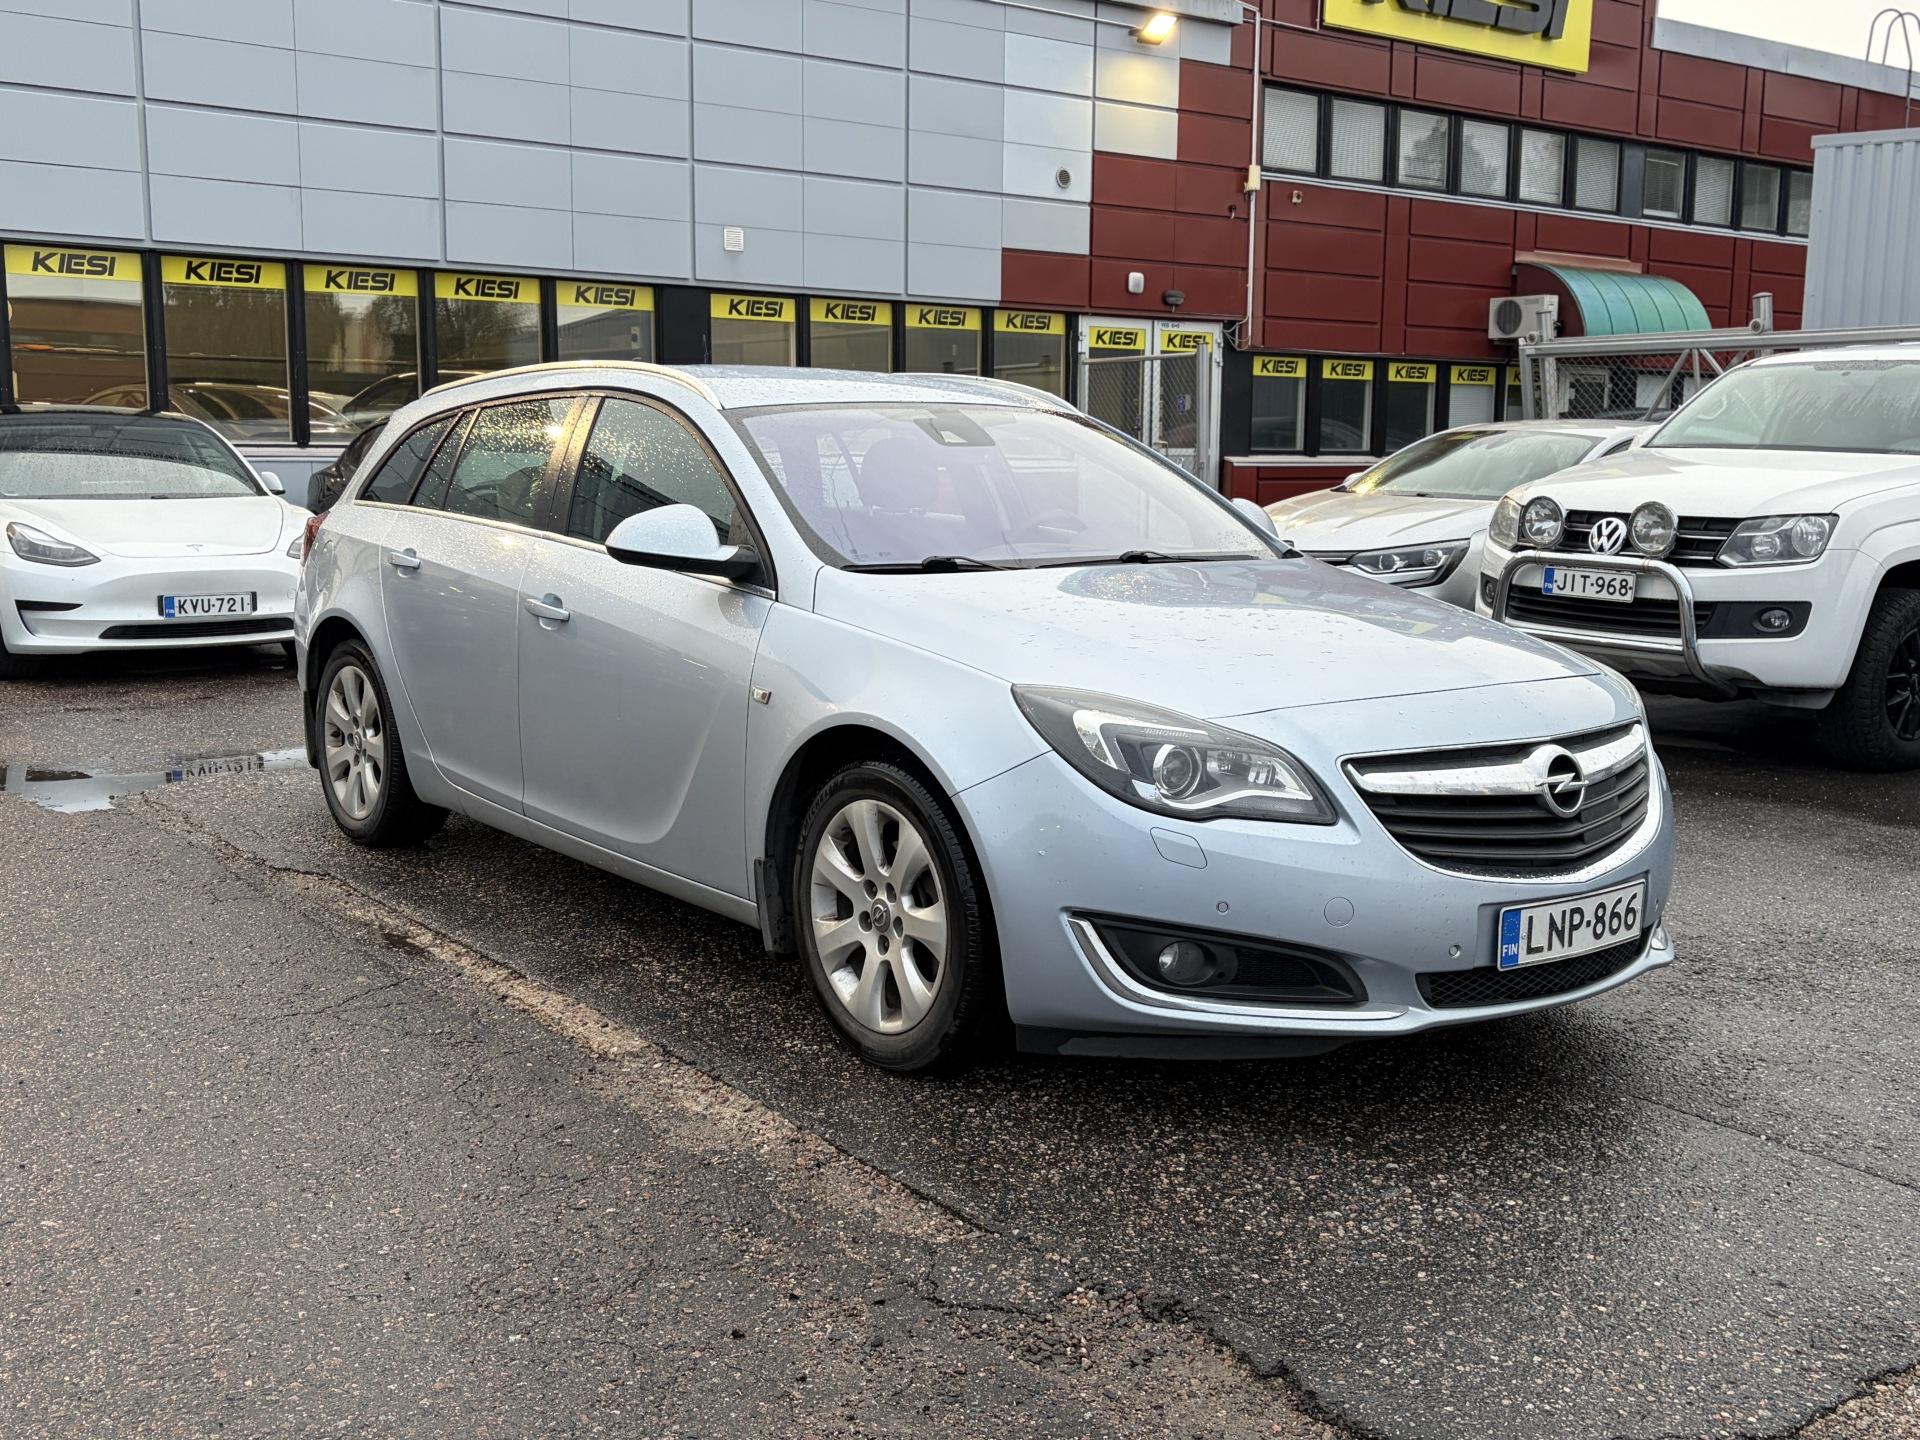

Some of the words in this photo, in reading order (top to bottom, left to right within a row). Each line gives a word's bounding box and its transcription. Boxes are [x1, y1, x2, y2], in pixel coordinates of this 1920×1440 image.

[32, 251, 116, 276] KIESI
[186, 260, 262, 283] KIESI
[325, 269, 396, 291] KIESI
[455, 277, 520, 299] KIESI
[575, 285, 636, 306] KIESI
[729, 299, 783, 317] KIESI
[825, 303, 876, 321] KIESI
[919, 309, 967, 326] KIESI
[1006, 313, 1051, 330] KIESI
[1096, 330, 1138, 346] KIESI
[1261, 359, 1298, 374] KIESI
[1330, 362, 1366, 377] KIESI
[1395, 365, 1429, 379] KIESI
[1457, 369, 1490, 383] KIESI
[1556, 573, 1629, 597] JIT-968
[178, 597, 245, 614] KVU-721
[1502, 944, 1519, 957] FIN
[1526, 892, 1638, 956] LNP-866
